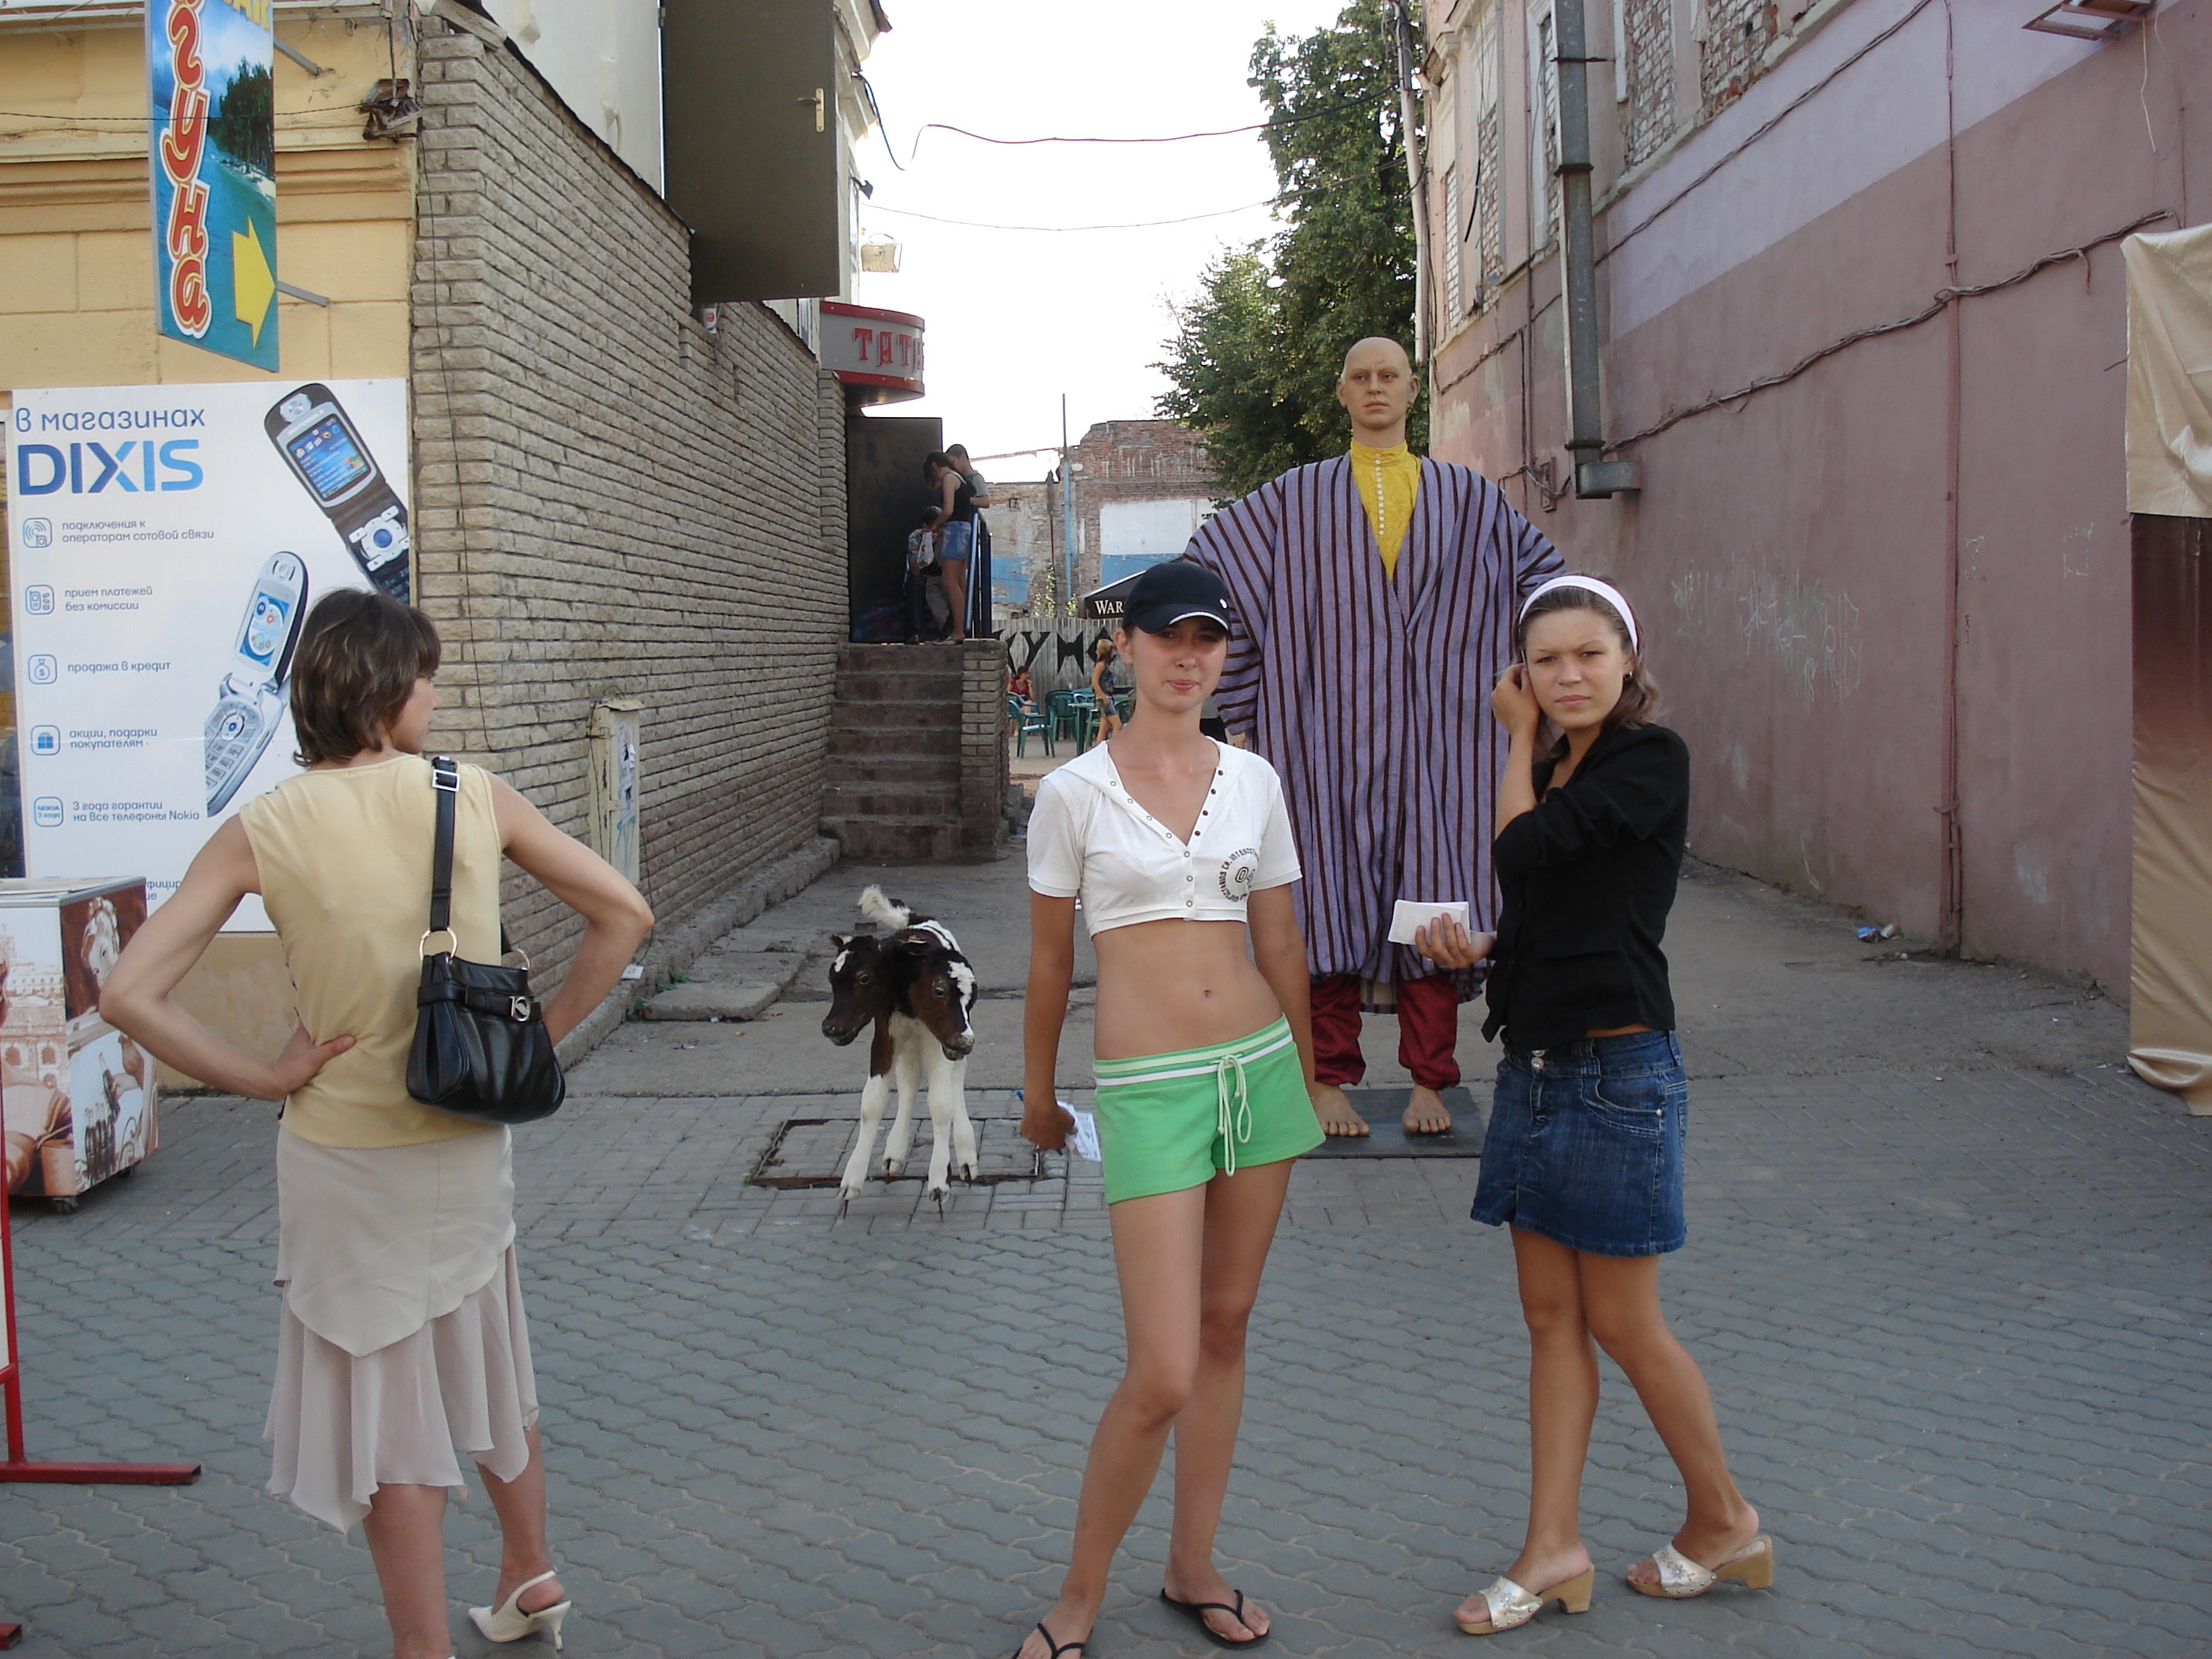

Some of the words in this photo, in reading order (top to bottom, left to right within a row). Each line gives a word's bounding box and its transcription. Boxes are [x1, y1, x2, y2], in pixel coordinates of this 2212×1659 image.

[161, 0, 211, 338] гуна
[16, 408, 31, 432] в
[42, 408, 205, 431] магазинах
[17, 439, 203, 496] DIXIS
[62, 521, 137, 532] подключения
[62, 533, 130, 544] операторам
[133, 530, 178, 540] сотовой
[181, 529, 214, 540] связи
[64, 589, 98, 599] прием
[101, 586, 152, 597] платежей
[65, 602, 84, 611] без
[87, 602, 139, 611] комиссии
[1094, 599, 1124, 615] WAR
[68, 663, 119, 674] продажа
[121, 661, 129, 671] в
[131, 662, 170, 673] кредит
[69, 730, 106, 739] акции,
[109, 729, 157, 739] подарки
[71, 740, 143, 750] покупателям
[73, 801, 79, 811] 3
[82, 803, 108, 812] года
[112, 801, 163, 811] гарантии
[73, 813, 86, 822] на
[90, 811, 109, 822] все
[112, 812, 167, 822] телефоны
[169, 810, 200, 821] Nokia
